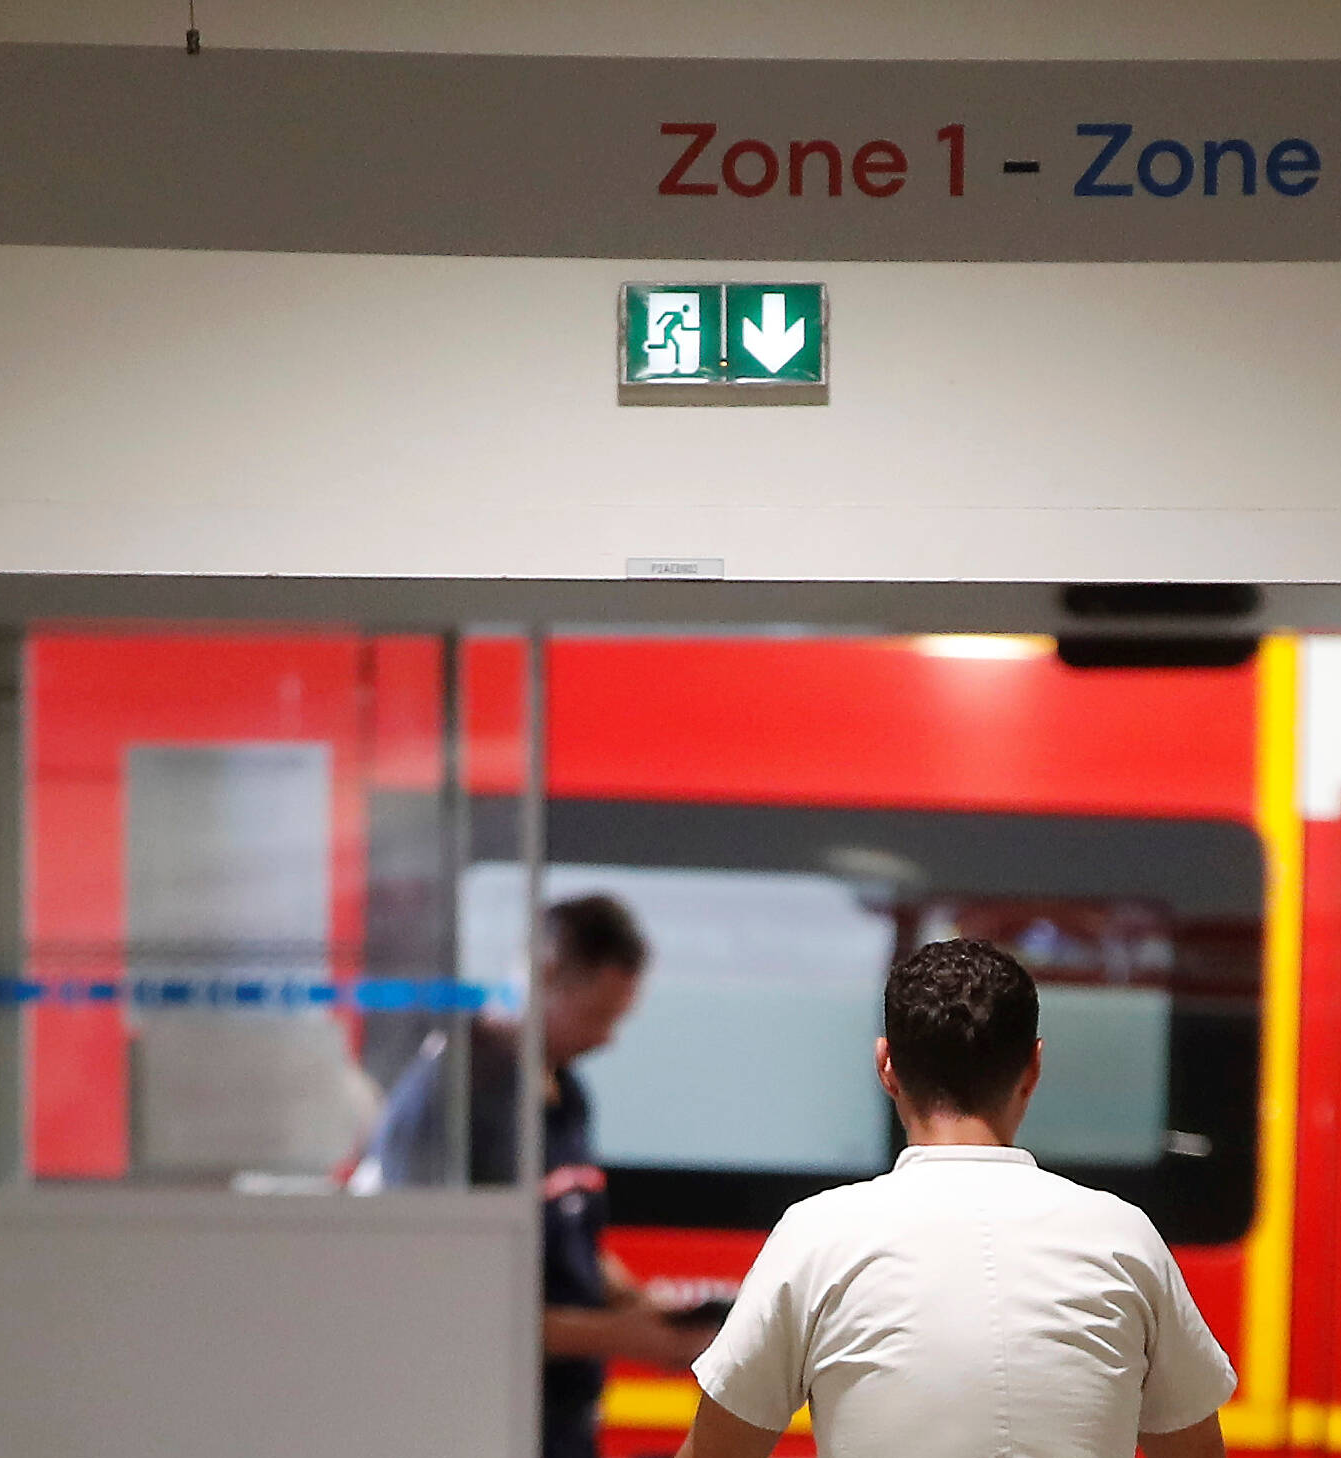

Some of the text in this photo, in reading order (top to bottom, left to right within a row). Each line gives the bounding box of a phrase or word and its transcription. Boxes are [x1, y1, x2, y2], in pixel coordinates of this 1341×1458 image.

[659, 122, 908, 198] Zone
[937, 123, 965, 197] 1
[1003, 159, 1040, 174] -
[1073, 122, 1322, 197] Zone
